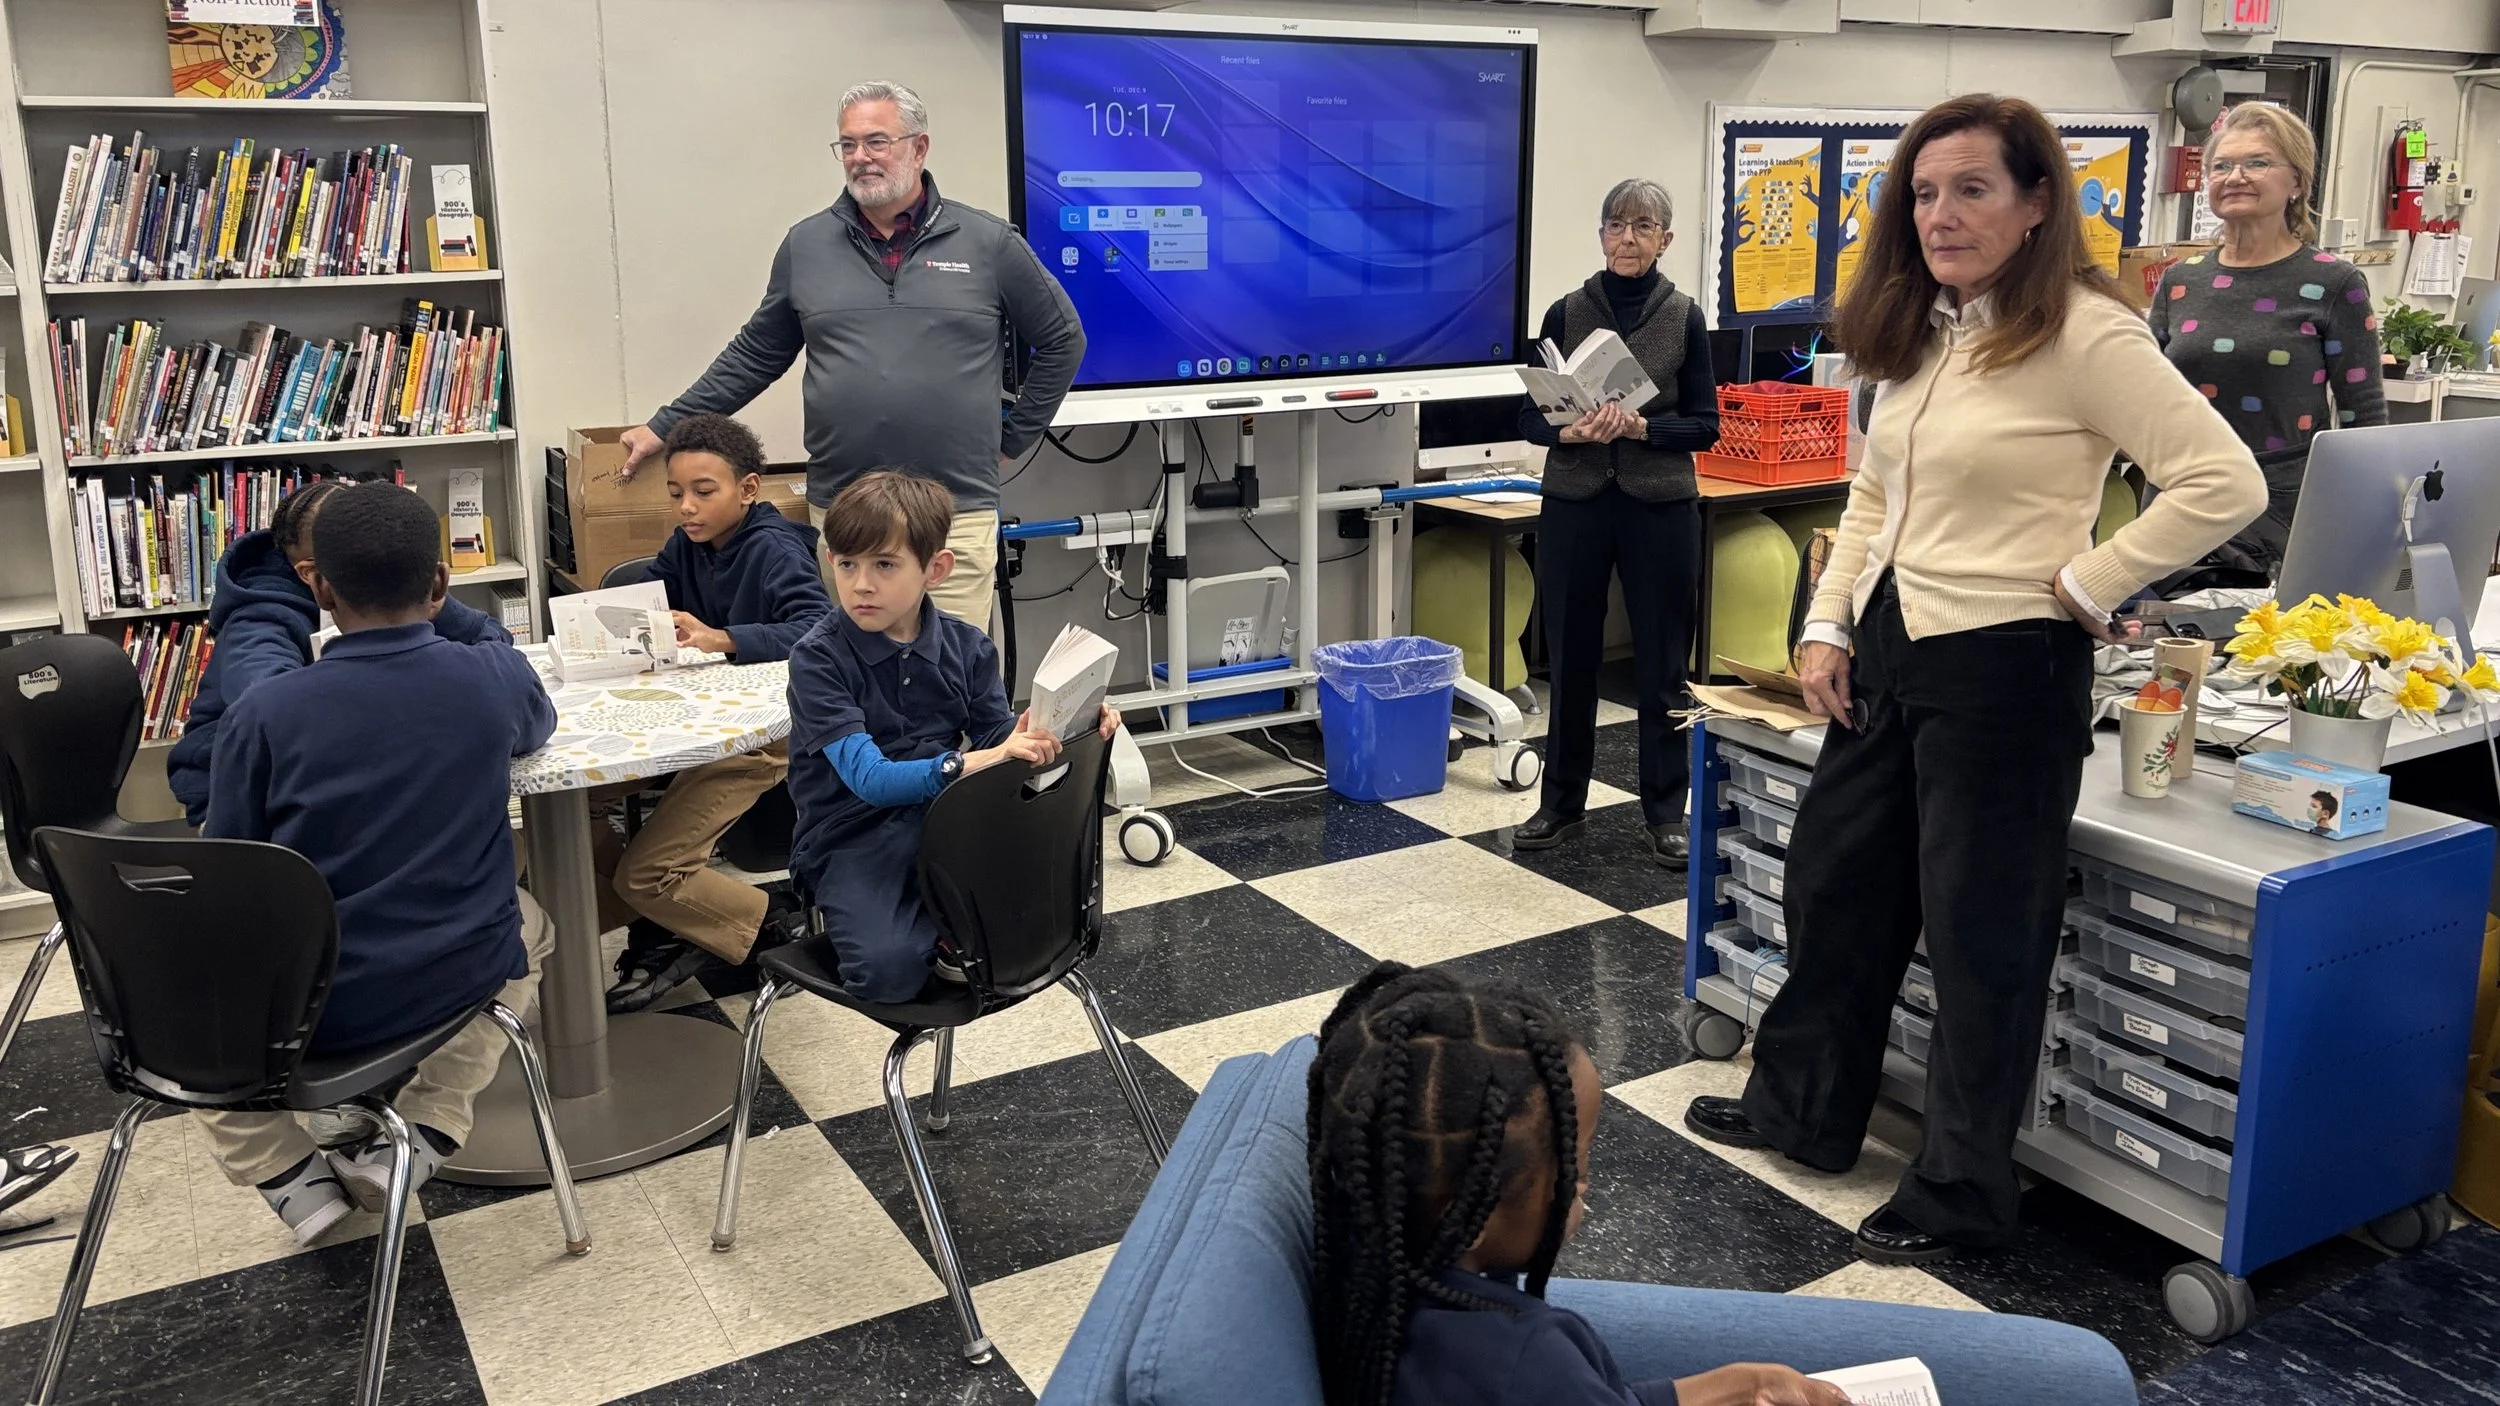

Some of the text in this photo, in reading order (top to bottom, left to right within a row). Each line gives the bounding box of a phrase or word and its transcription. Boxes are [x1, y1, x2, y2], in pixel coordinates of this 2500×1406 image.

[1220, 55, 1260, 65] Recent files
[1478, 72, 1506, 83] SMART
[1306, 96, 1347, 105] Favorite files
[1085, 102, 1175, 137] 10:17
[1739, 158, 1768, 167] Learning
[1776, 158, 1804, 167] teaching
[1875, 159, 1885, 167] the
[1747, 168, 1757, 176] the
[1758, 168, 1772, 176] PYP
[66, 167, 78, 206] HISTORY
[60, 208, 68, 230] YEAR
[52, 245, 60, 267] YEAR
[414, 336, 422, 364] AMERICAN
[261, 368, 269, 388] AGENT
[181, 368, 196, 409] UNBREAKABLE
[179, 506, 187, 524] NOW
[147, 541, 156, 559] RIGHT
[24, 676, 57, 685] Literature
